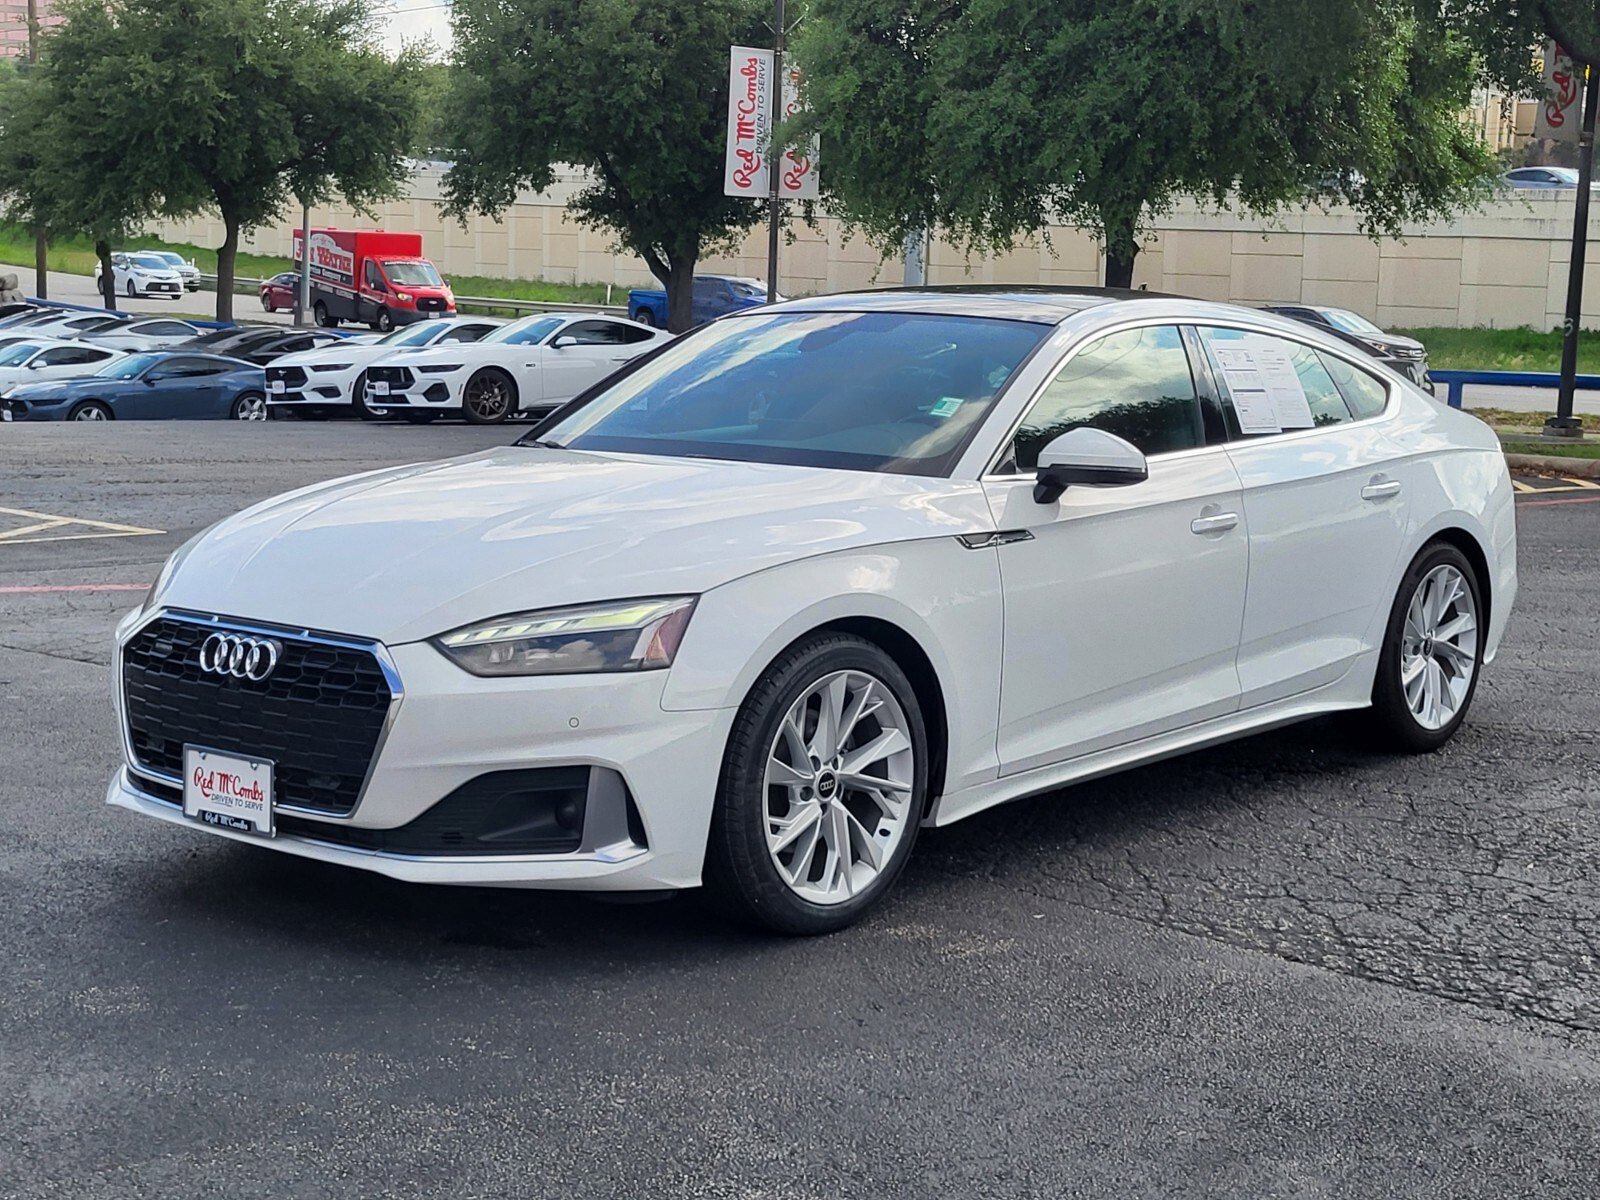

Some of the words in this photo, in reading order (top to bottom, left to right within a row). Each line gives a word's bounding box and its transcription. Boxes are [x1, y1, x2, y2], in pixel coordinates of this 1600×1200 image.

[758, 58, 766, 93] SERVE
[736, 57, 758, 145] McCombs
[757, 95, 764, 110] TO
[756, 114, 765, 154] DRIVEN
[732, 148, 761, 188] Red
[194, 766, 214, 797] Red
[216, 772, 264, 802] McCombs
[211, 793, 233, 805] DRIVEN
[234, 798, 243, 807] TO
[244, 800, 264, 811] SERVE
